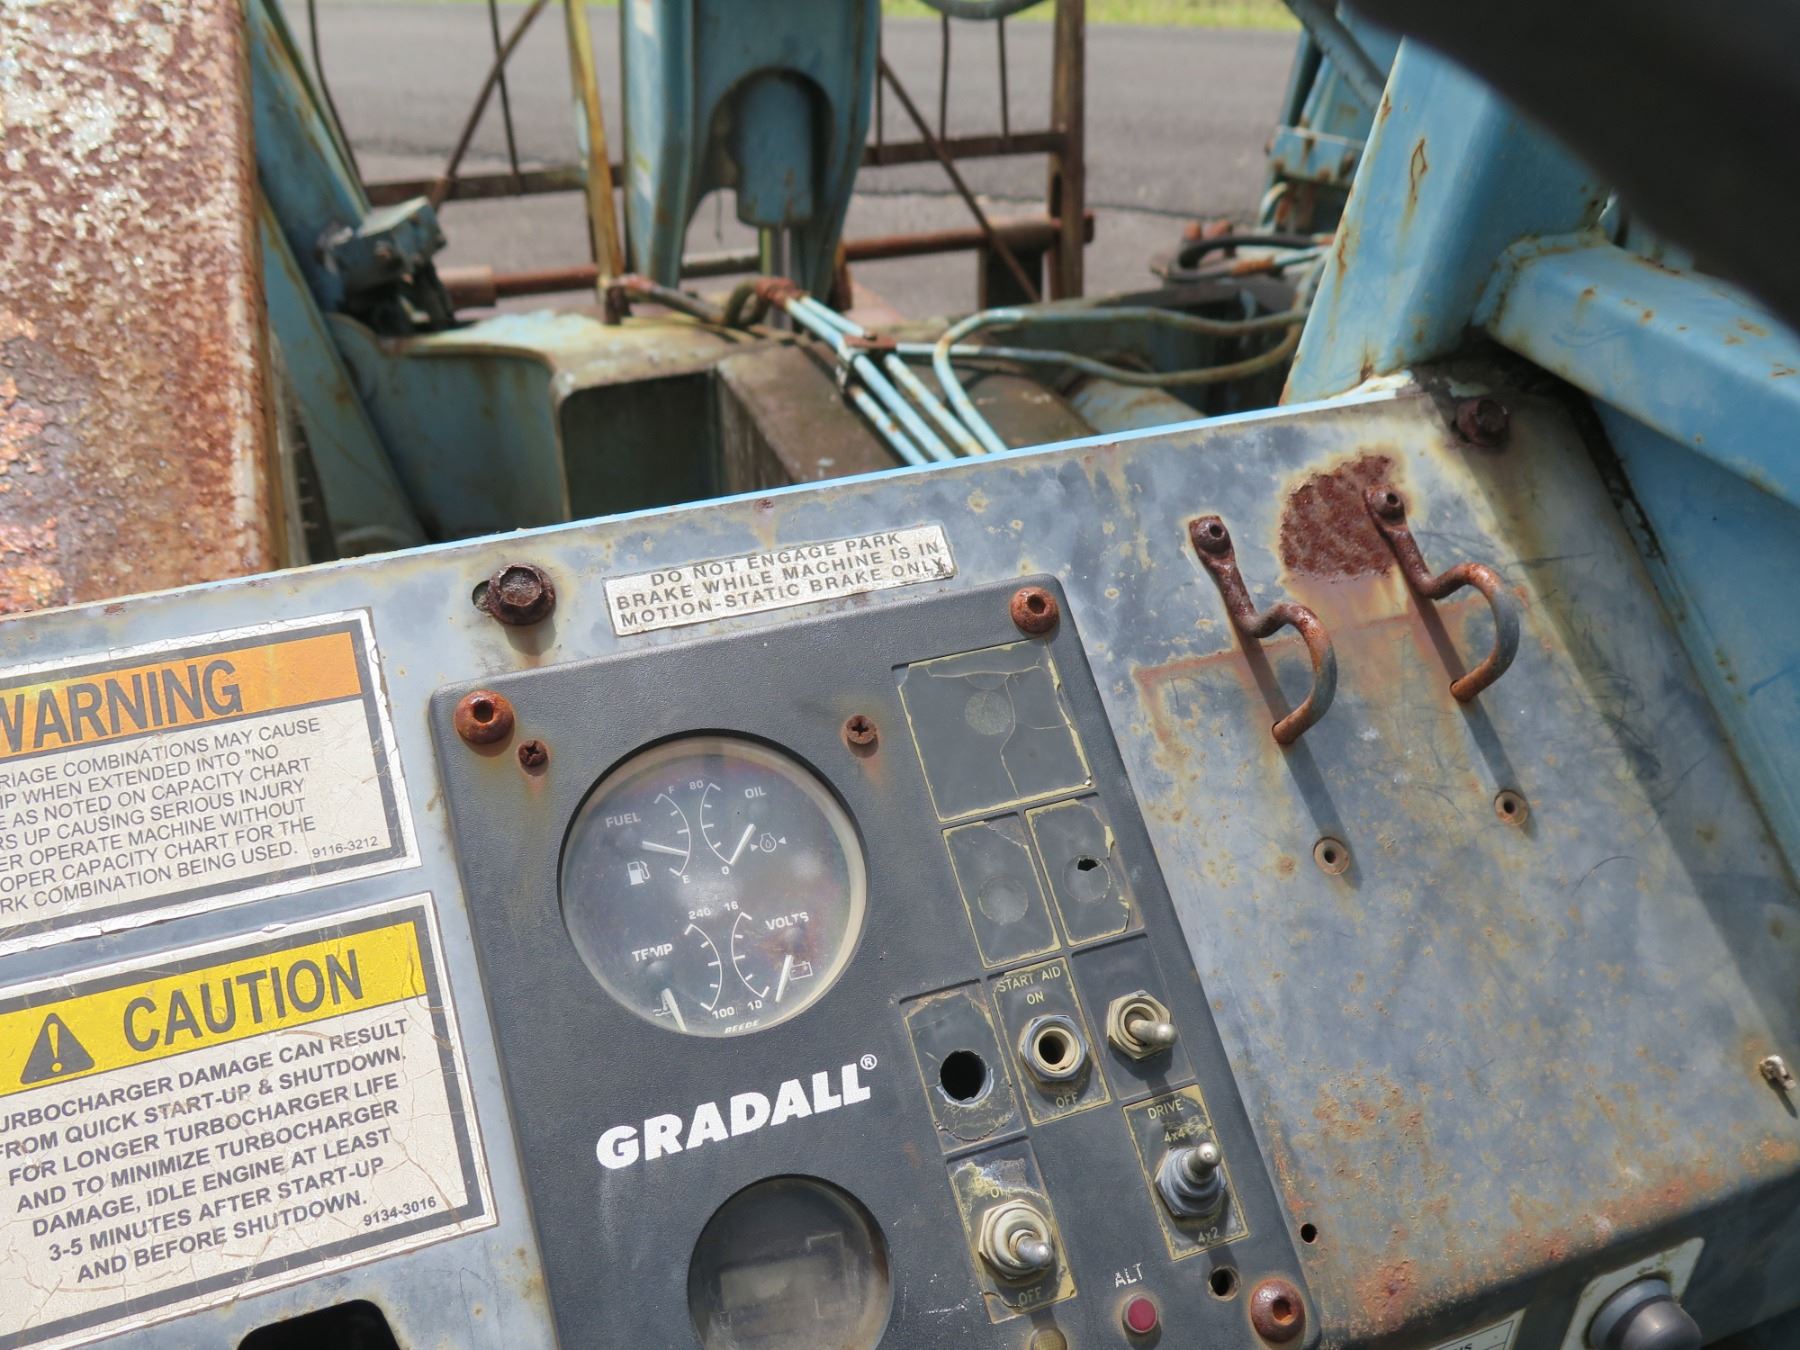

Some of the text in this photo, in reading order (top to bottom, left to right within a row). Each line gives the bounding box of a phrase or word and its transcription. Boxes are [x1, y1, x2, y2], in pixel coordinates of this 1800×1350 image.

[650, 531, 902, 587] DO NOT ENGAGE PARK
[616, 542, 940, 611] BRAKE WHILE MACHINE IS IN
[809, 568, 883, 593] BRAKE
[63, 738, 209, 777] COMBINATIONS
[214, 729, 253, 750] MAY
[258, 717, 320, 741] CAUSE
[23, 780, 82, 805] WHEN
[88, 760, 190, 793] EXTENDED
[196, 751, 240, 773] INTO
[668, 786, 675, 795] F
[688, 780, 704, 790] 80
[12, 809, 39, 828] AS
[44, 795, 112, 822] NOTED
[117, 788, 146, 807] ON
[151, 769, 244, 800] CAPACITY
[249, 757, 311, 782] CHART
[744, 786, 766, 799] OIL
[24, 827, 50, 846] UP
[57, 809, 145, 840] CAUSING
[150, 792, 235, 821] SERIOUS
[239, 778, 305, 804] INJURY
[605, 813, 641, 828] FUEL
[29, 834, 123, 866] OPERATE
[128, 815, 217, 846] MACHINE
[220, 797, 306, 828] WITHOUT
[0, 816, 316, 893] OPER CAPACITY CHART FOR THE
[312, 836, 378, 858] 9116-3212
[0, 840, 298, 914] RK COMBINATION BEING USED.
[682, 875, 691, 884] E
[688, 907, 712, 920] 240
[723, 901, 739, 911] 16
[765, 911, 809, 930] VOLTS
[631, 943, 673, 962] TEMP
[998, 966, 1061, 993] START AID
[122, 949, 364, 1053] CAUTION
[747, 1000, 763, 1011] 10
[1026, 991, 1045, 1005] ON
[711, 1006, 735, 1019] 100
[179, 1052, 273, 1089] DAMAGE
[278, 1039, 324, 1064] CAN
[329, 1018, 407, 1051] RESULT
[65, 1111, 138, 1144] QUICK
[143, 1083, 251, 1124] START-UP
[258, 1078, 273, 1096] &
[279, 1045, 406, 1090] SHUTDOWN.
[1055, 1092, 1078, 1109] OFF
[1147, 1099, 1184, 1120] DRIVE
[8, 1073, 399, 1186] FOR LONGER TURBOCHARGER LIFE
[16, 1100, 399, 1213] AND TO MINIMIZE TURBOCHARGER
[32, 1127, 391, 1237] DAMAGE, IDLE ENGINE AT LEAST
[49, 1156, 384, 1261] 3-5 MINUTES AFTER START-UP
[362, 1196, 437, 1227] 9134-3016
[77, 1190, 367, 1283] AND BEFORE SHUTDOWN.
[1113, 1263, 1144, 1287] ALT
[1018, 1286, 1042, 1304] OFF
